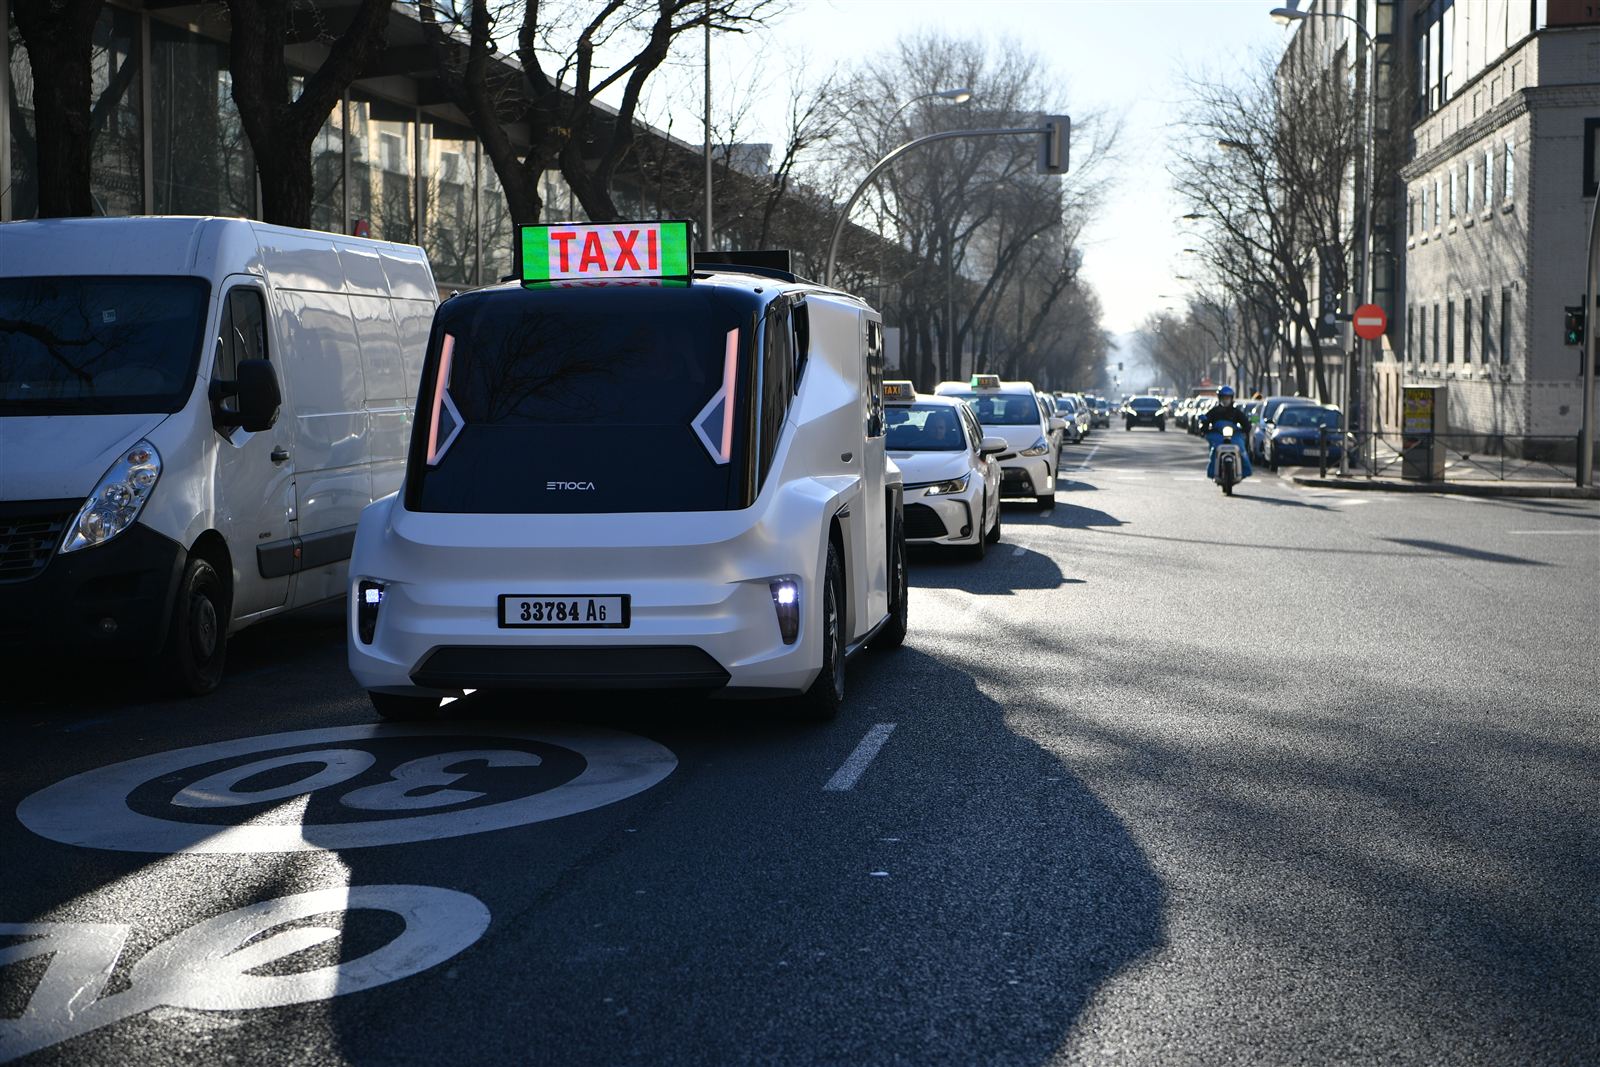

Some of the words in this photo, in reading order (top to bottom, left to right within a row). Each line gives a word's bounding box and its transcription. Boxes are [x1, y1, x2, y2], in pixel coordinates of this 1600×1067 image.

[551, 229, 658, 273] TAXI
[884, 385, 900, 395] TAXI
[546, 481, 595, 490] ETIOCA
[520, 601, 579, 621] 33784
[587, 599, 607, 621] A6
[171, 749, 542, 809] 30
